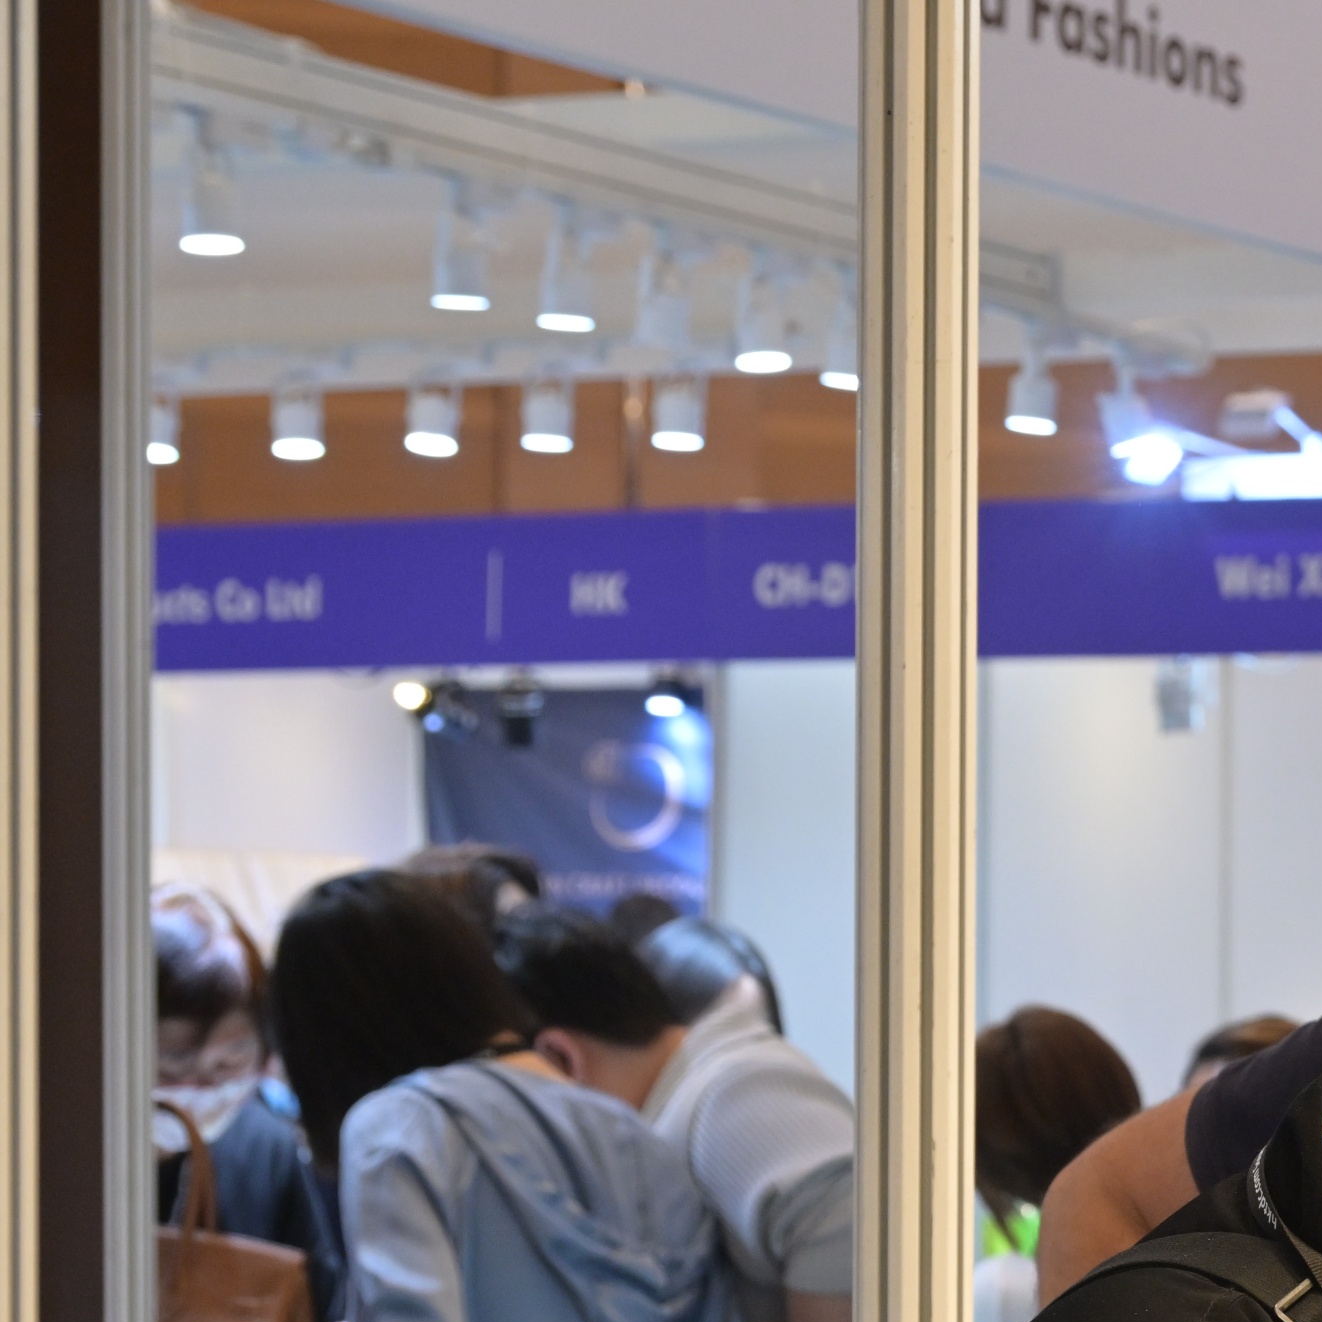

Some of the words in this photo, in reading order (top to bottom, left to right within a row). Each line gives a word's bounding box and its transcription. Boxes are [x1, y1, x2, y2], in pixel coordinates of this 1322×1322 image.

[1028, 0, 1245, 107] Fashions
[570, 571, 628, 616] HK
[754, 562, 855, 608] CH-D
[1215, 554, 1290, 599] Wei
[215, 577, 261, 623] Co
